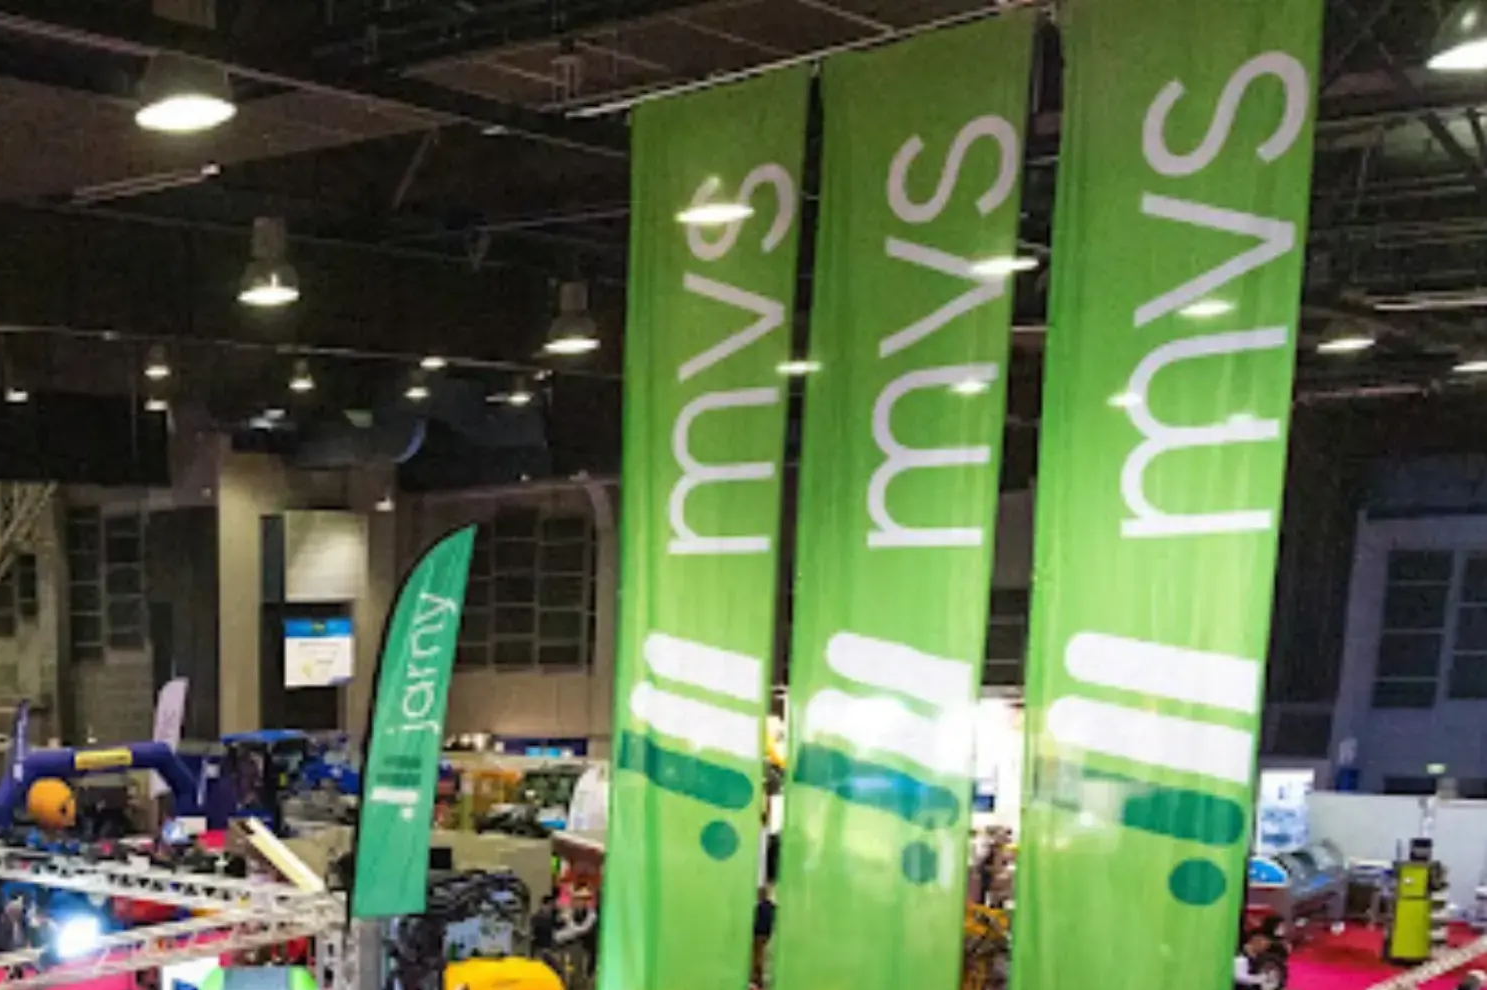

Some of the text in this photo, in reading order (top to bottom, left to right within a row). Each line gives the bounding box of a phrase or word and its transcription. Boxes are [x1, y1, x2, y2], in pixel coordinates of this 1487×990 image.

[667, 162, 795, 555] mvs
[867, 114, 1021, 549] mvs
[1120, 51, 1310, 538] mvs
[385, 592, 458, 735] jarny
